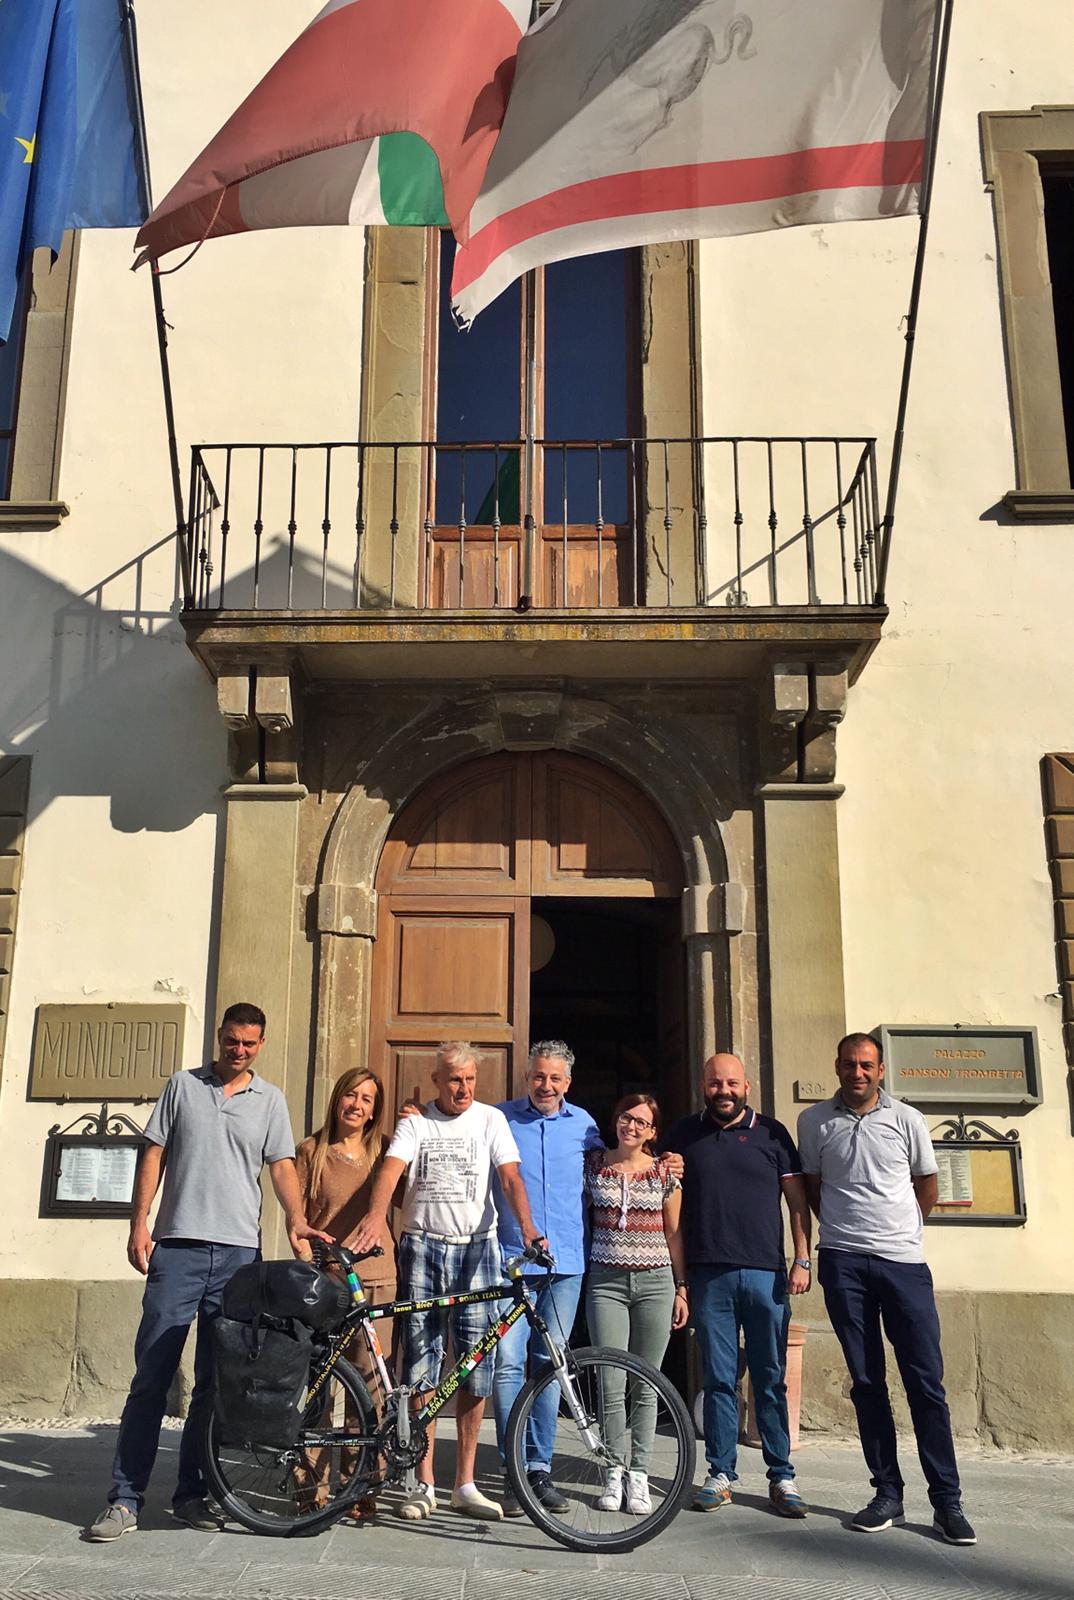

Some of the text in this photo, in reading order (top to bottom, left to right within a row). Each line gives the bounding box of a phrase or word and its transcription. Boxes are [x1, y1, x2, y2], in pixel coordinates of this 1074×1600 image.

[40, 1021, 178, 1079] MUNICIPIO
[934, 1049, 986, 1060] PALAZZO
[899, 1067, 1024, 1080] SANSONI TROMBETTA
[482, 1291, 502, 1300] ITALY
[427, 1399, 445, 1418] ROMA
[443, 1381, 459, 1399] 2000
[506, 1303, 527, 1325] PEKING
